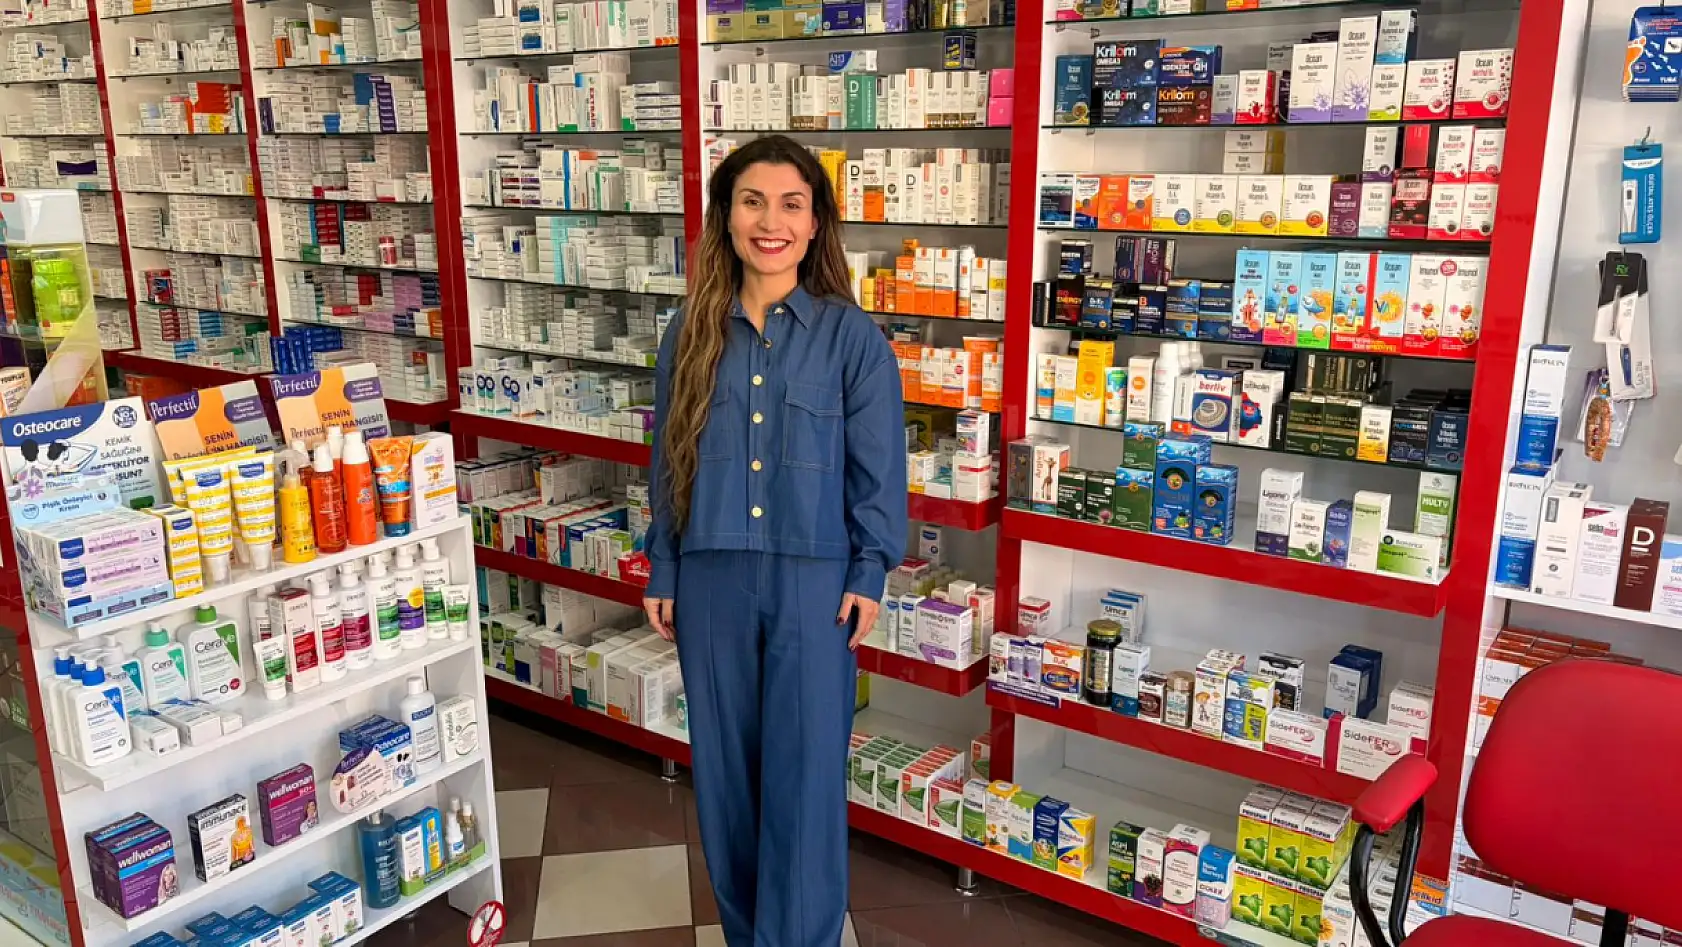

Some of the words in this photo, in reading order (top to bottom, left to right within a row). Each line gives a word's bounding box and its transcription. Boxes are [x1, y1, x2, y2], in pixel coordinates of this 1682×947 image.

[1096, 45, 1137, 58] Krilom
[1475, 58, 1493, 67] Ocean
[1104, 90, 1137, 101] Krilom
[1158, 86, 1195, 101] Krilom
[850, 166, 860, 177] D
[906, 174, 916, 186] D
[273, 374, 318, 394] Perfectil
[151, 395, 198, 416] Perfectil
[321, 409, 350, 421] SENİN
[12, 416, 81, 437] Osteocare
[105, 434, 132, 446] KEMİK
[204, 431, 234, 444] SENİN
[1632, 526, 1655, 546] D
[1104, 605, 1127, 615] Umca
[195, 634, 235, 654] CeraVe
[152, 656, 184, 672] CeraVe
[84, 694, 120, 713] CeraVe
[1270, 720, 1306, 735] SideFER
[1344, 729, 1390, 748] SideFER
[269, 774, 313, 800] wellwoman
[1242, 808, 1267, 821] PROSPAN
[1273, 816, 1299, 830] PROSPAN
[1305, 826, 1331, 839] PROSPAN
[118, 839, 171, 869] wellwoman
